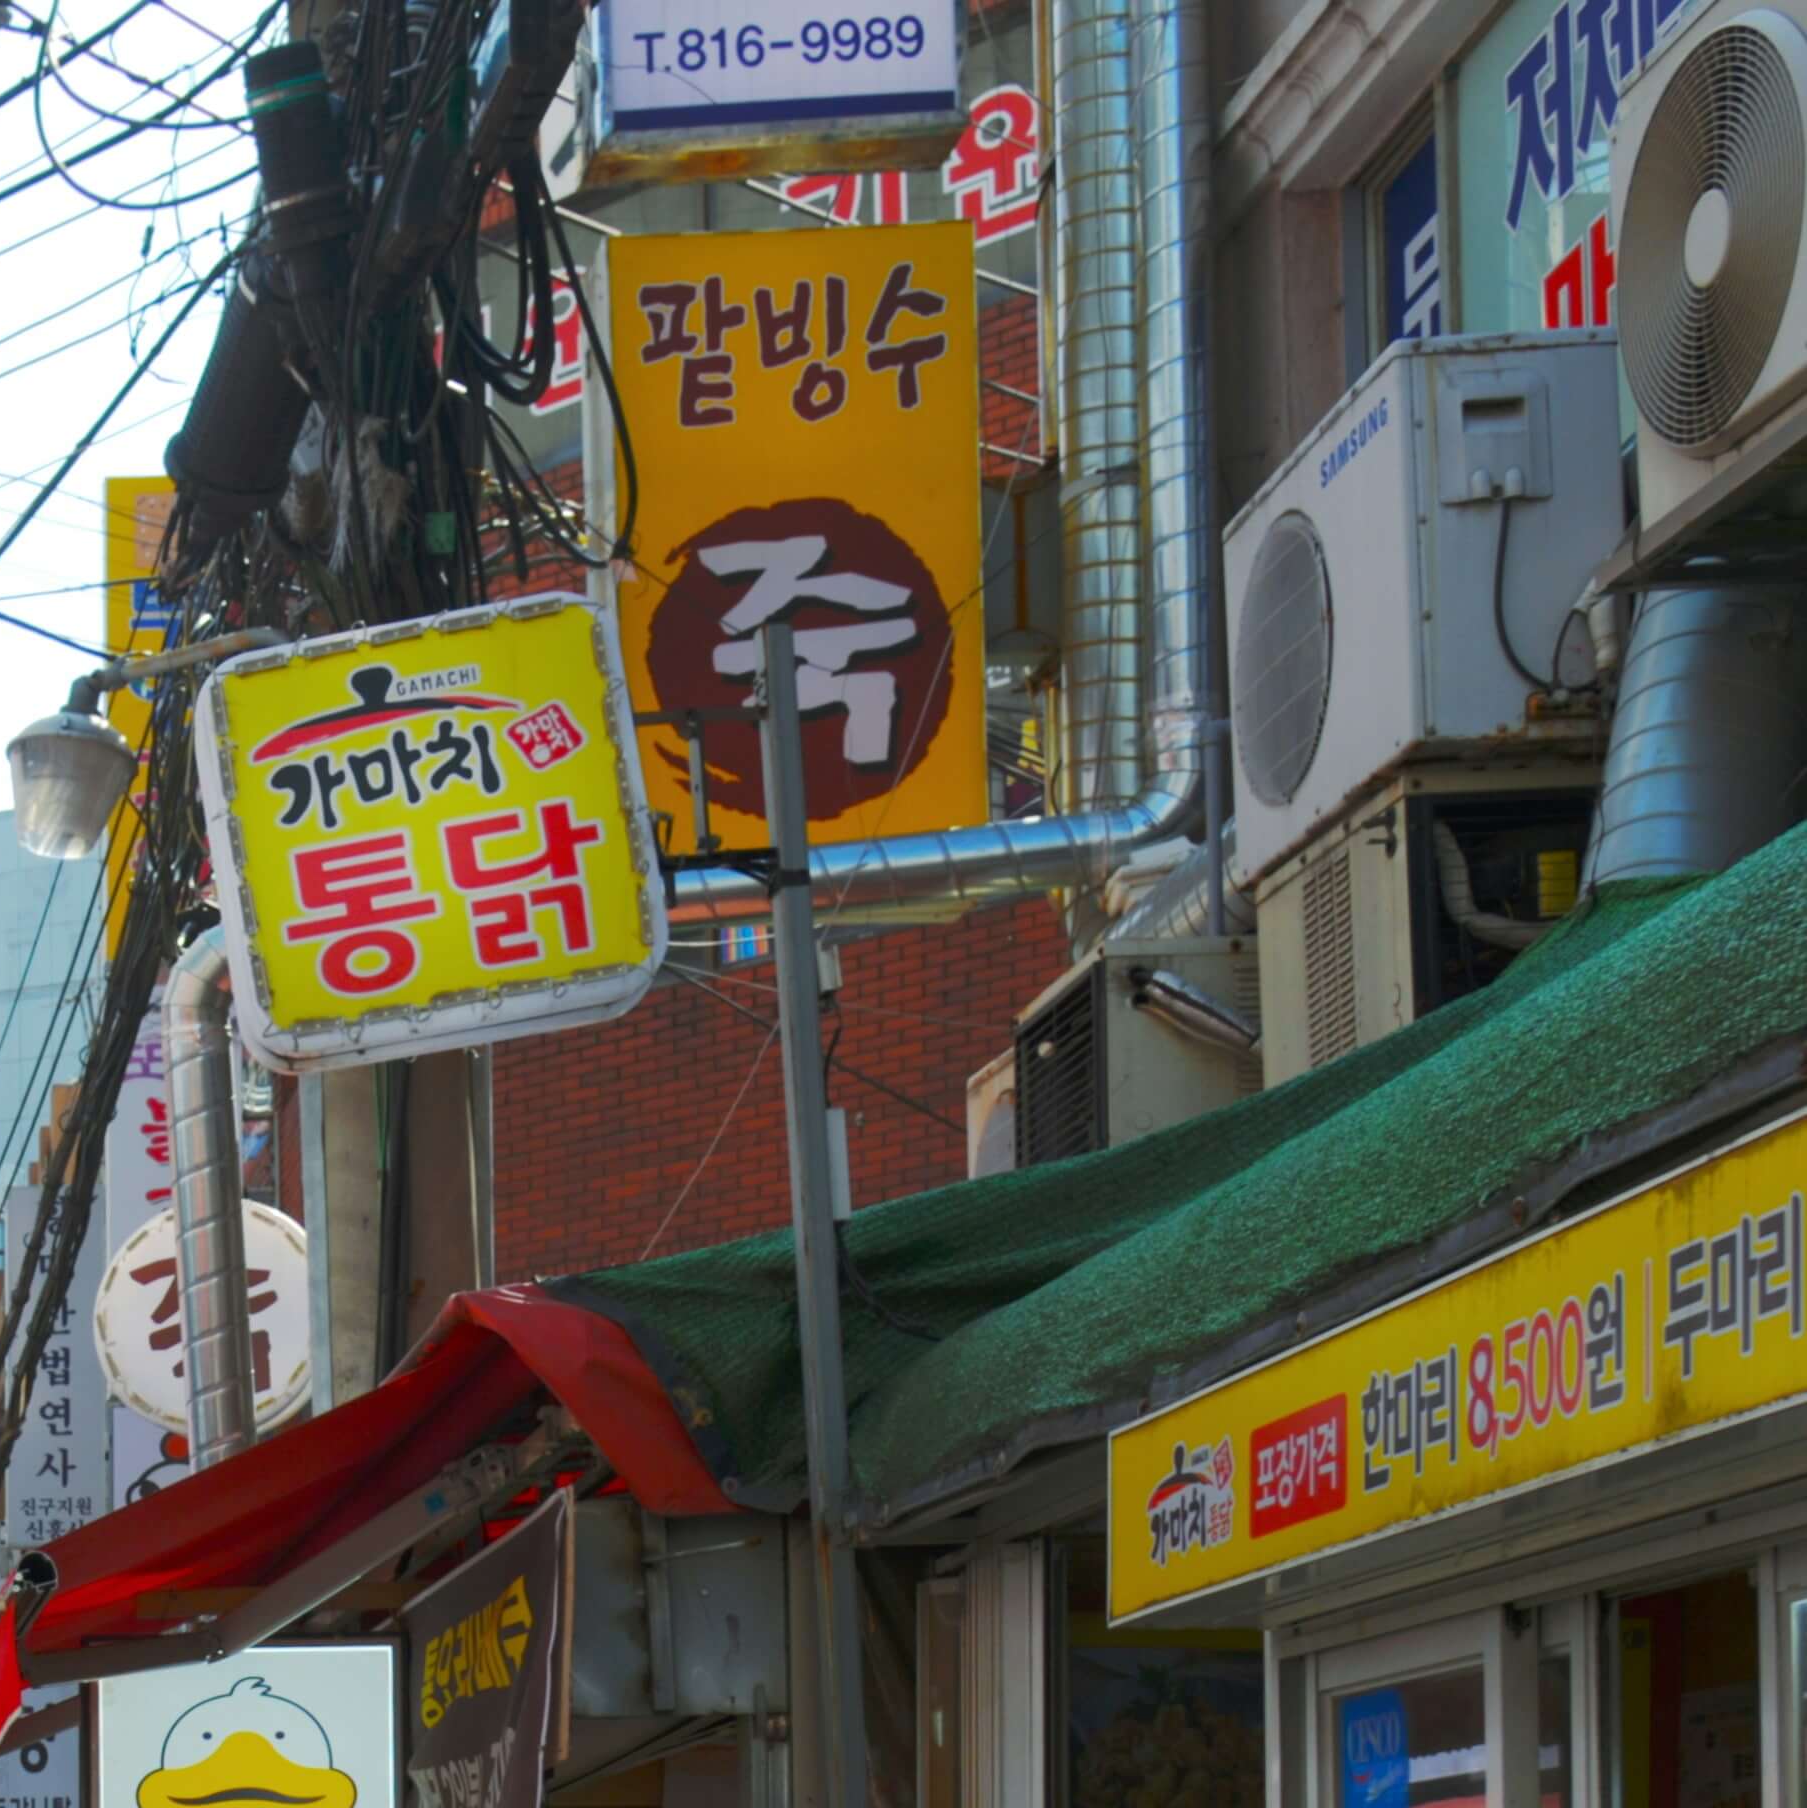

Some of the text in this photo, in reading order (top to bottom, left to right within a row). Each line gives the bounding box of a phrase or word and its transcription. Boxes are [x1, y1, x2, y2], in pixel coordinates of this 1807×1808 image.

[633, 15, 926, 75] T.816-9989
[639, 263, 947, 428] 팥빙수
[1320, 396, 1390, 488] SAMSUNG
[395, 664, 481, 696] GAMACHI
[269, 720, 501, 830] 가마치
[286, 800, 605, 996] 통닭
[1665, 1190, 1805, 1378] 두마리
[1465, 1270, 1627, 1456] 8,500원
[1254, 1417, 1341, 1514] 포장가격
[1361, 1345, 1458, 1492] 한마리
[1151, 1487, 1206, 1565] 가마치
